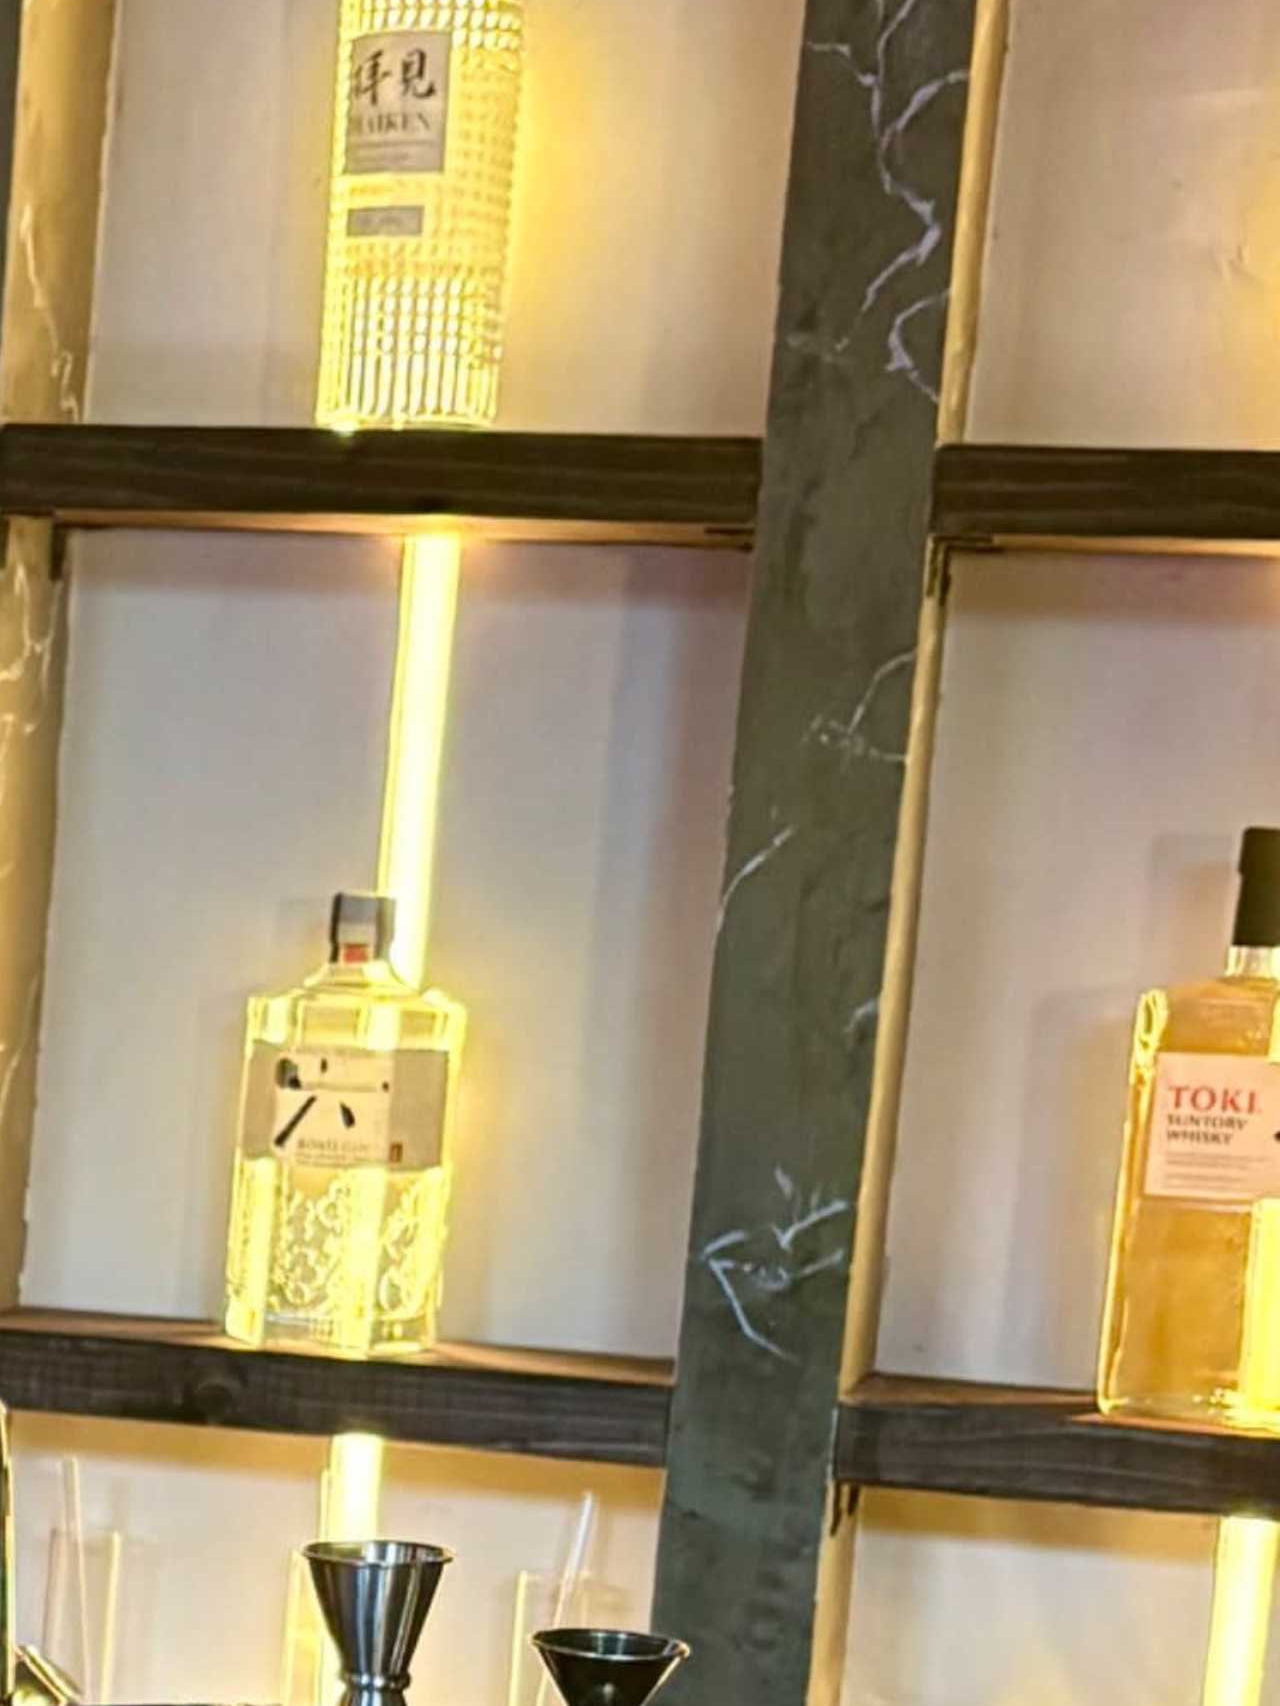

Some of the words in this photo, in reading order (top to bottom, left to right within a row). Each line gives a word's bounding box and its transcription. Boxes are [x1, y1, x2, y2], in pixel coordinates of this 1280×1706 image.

[1168, 1084, 1260, 1115] TOKI
[1167, 1112, 1248, 1131] SUNTORY
[1166, 1128, 1233, 1145] WHISKY
